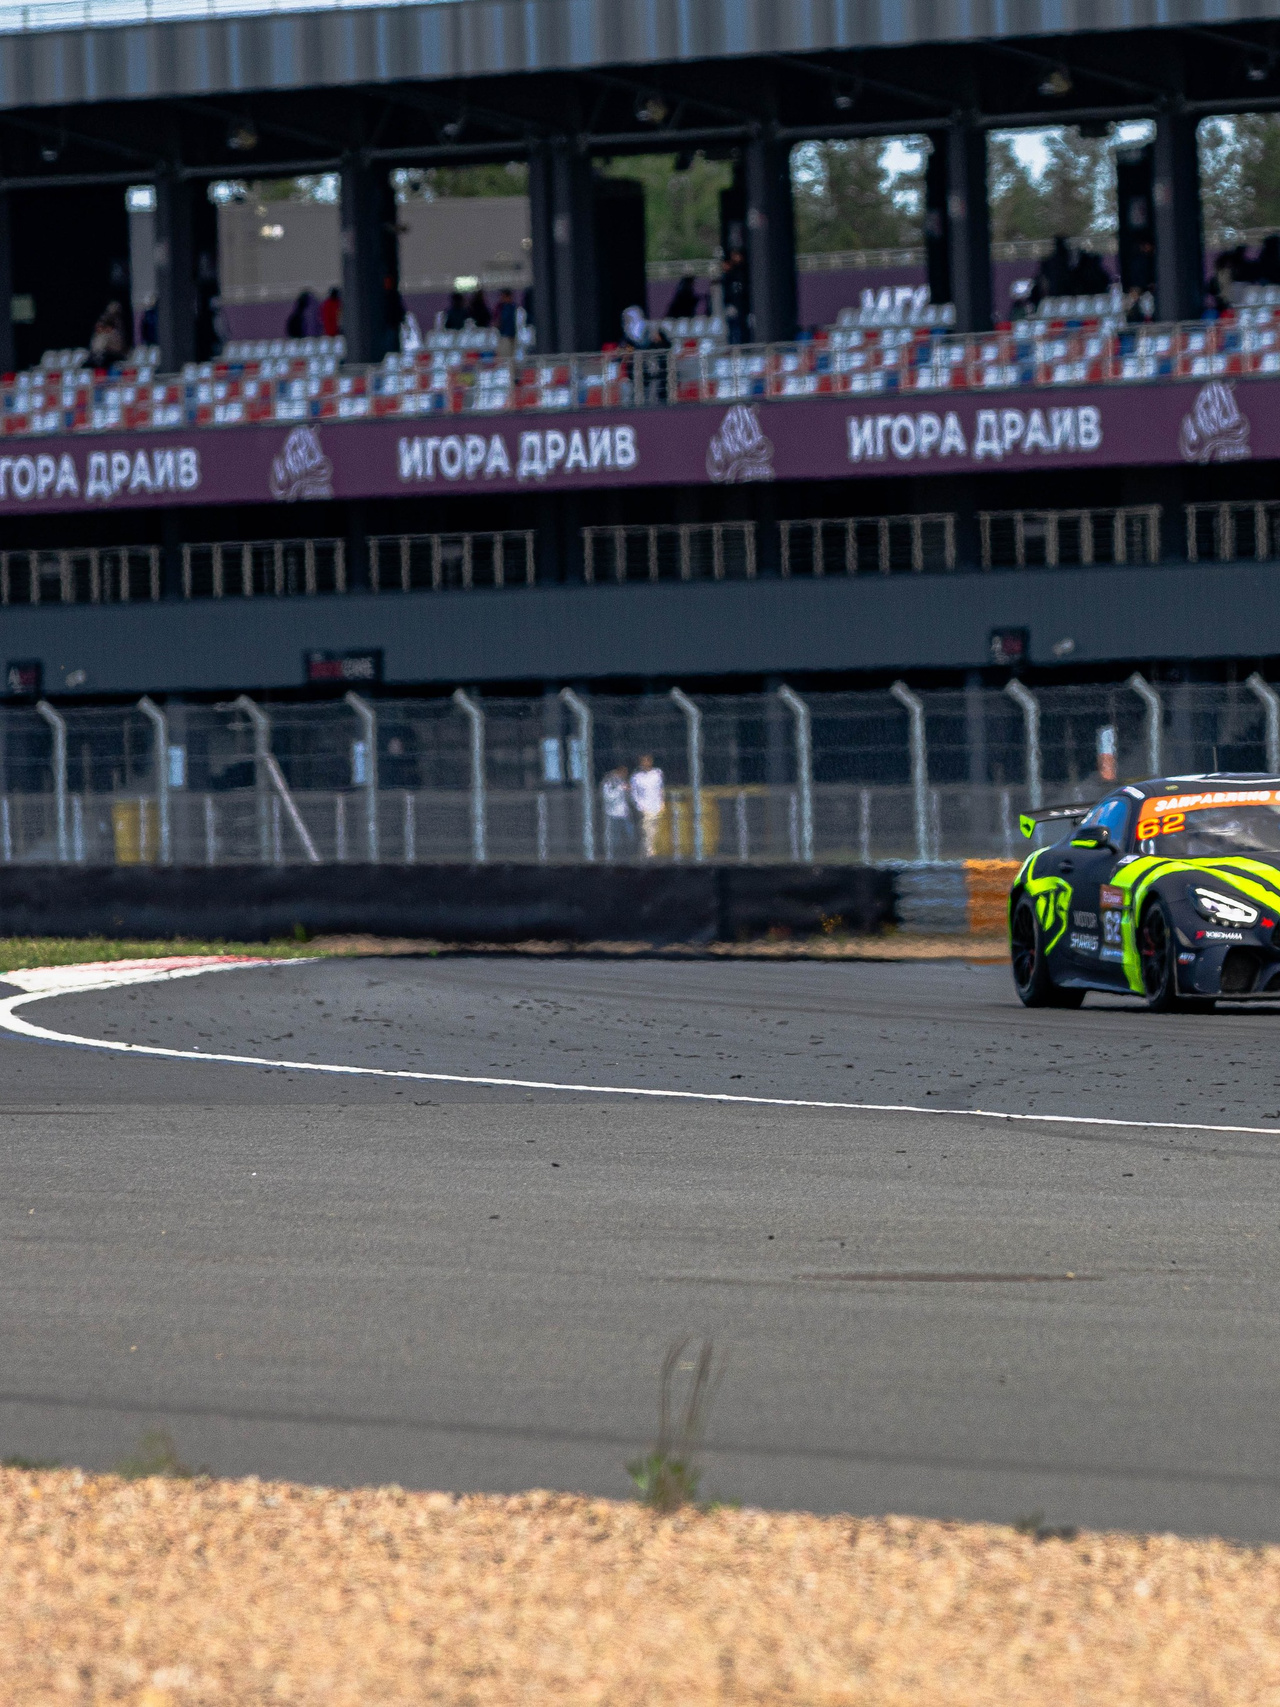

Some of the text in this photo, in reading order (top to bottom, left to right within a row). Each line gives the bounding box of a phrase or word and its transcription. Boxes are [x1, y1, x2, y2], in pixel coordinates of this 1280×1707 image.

[397, 434, 511, 481] ИГОРА
[846, 412, 966, 461] ИГОРА
[0, 453, 79, 498] ГОРА
[1154, 791, 1271, 812] ЗАПРАВЛЕНО
[1136, 813, 1186, 841] 62
